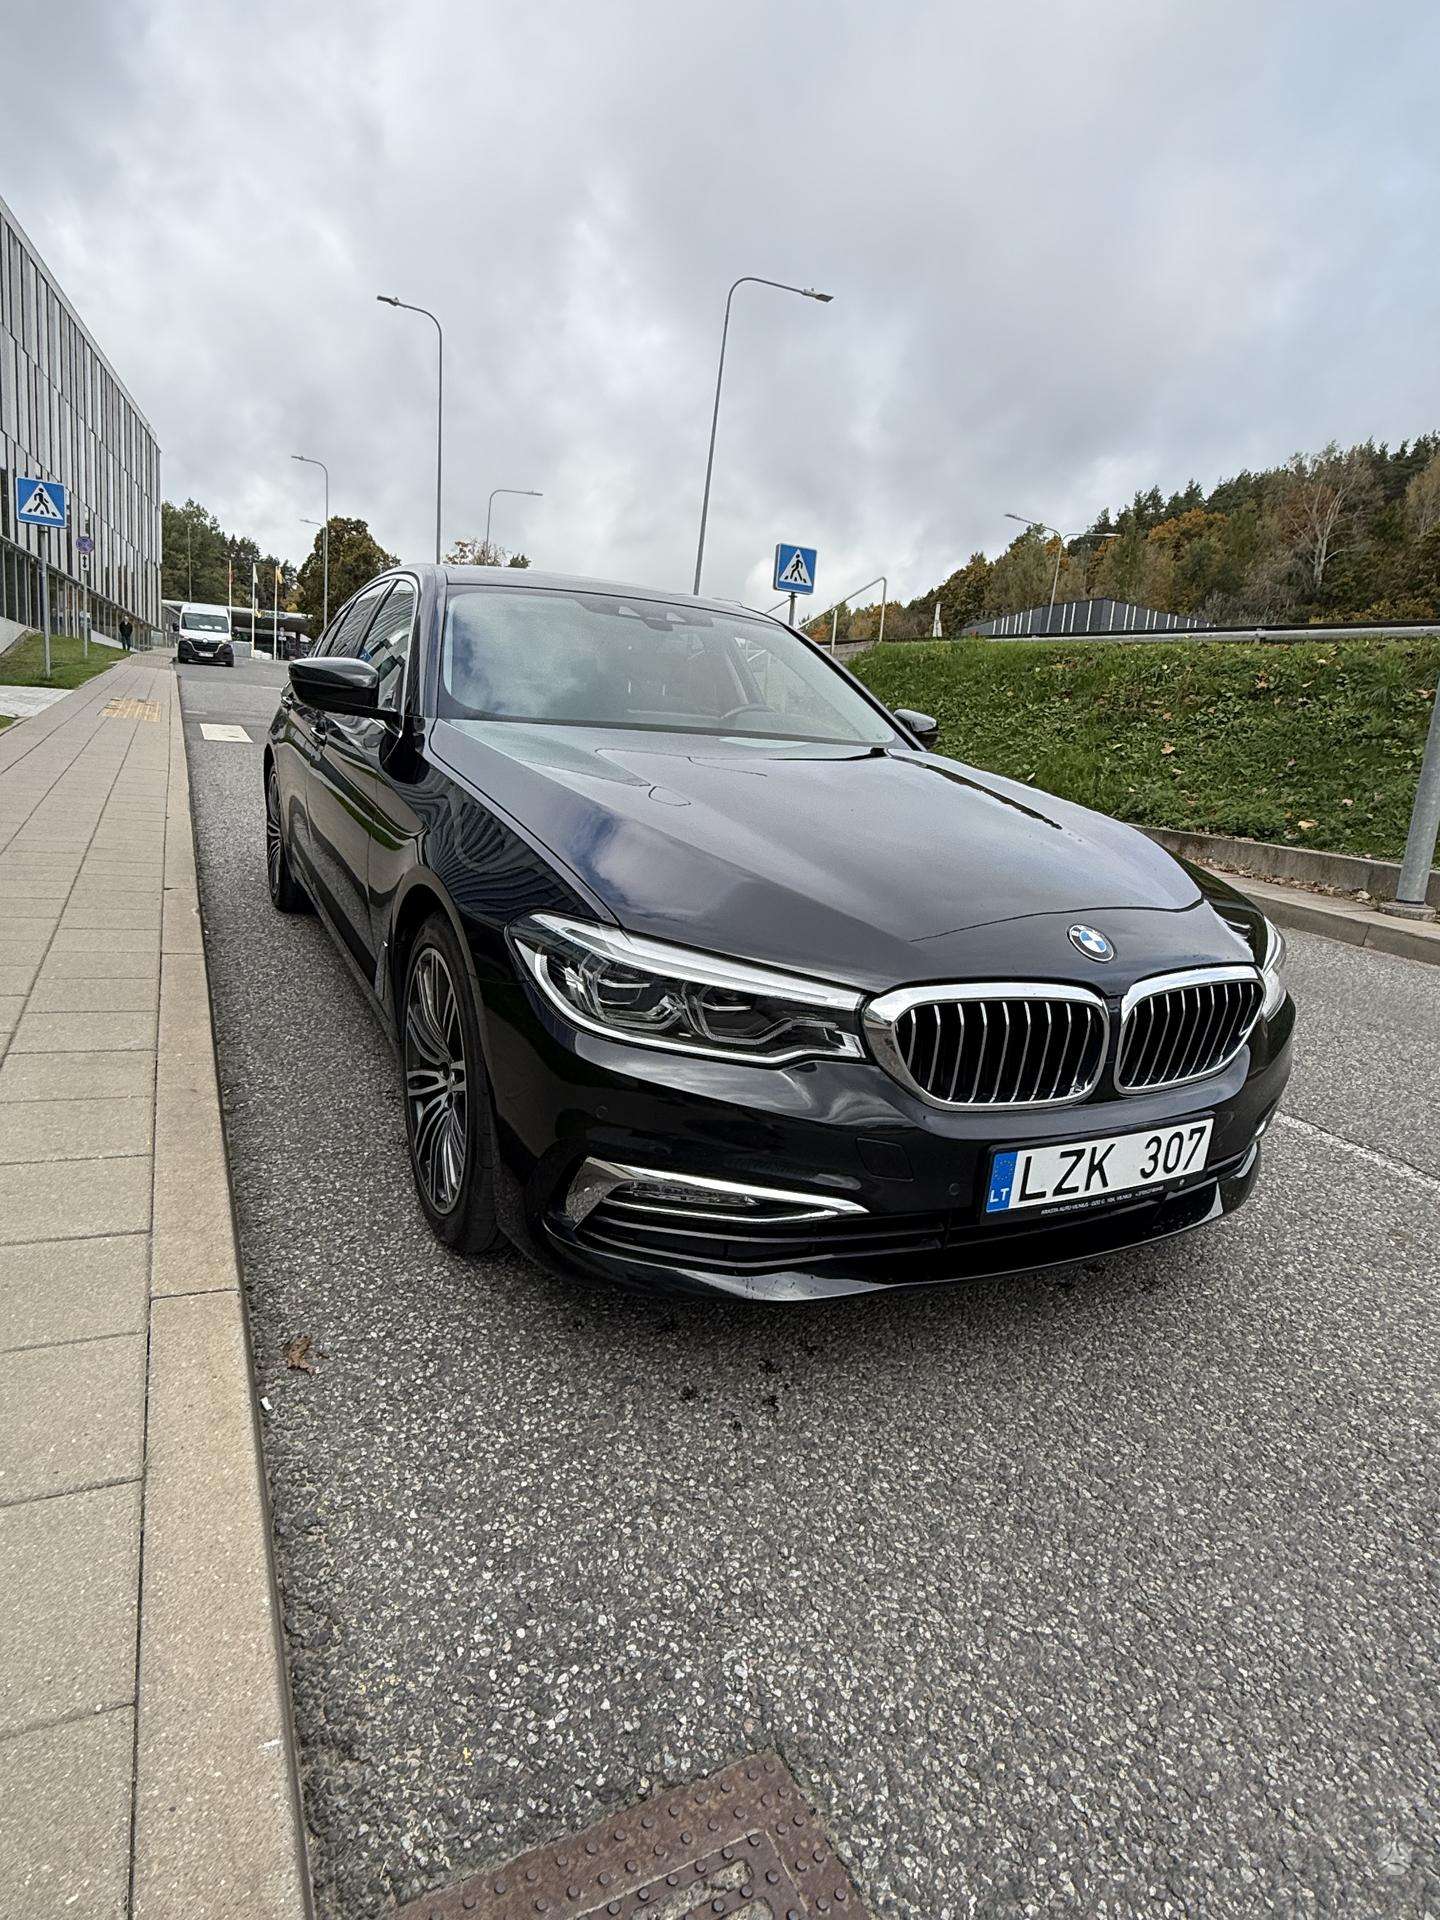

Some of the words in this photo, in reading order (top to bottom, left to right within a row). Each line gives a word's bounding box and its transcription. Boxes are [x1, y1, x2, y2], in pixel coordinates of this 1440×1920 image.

[1018, 1143, 1116, 1203] LZK
[1139, 1126, 1207, 1179] 307
[989, 1187, 1009, 1203] LT
